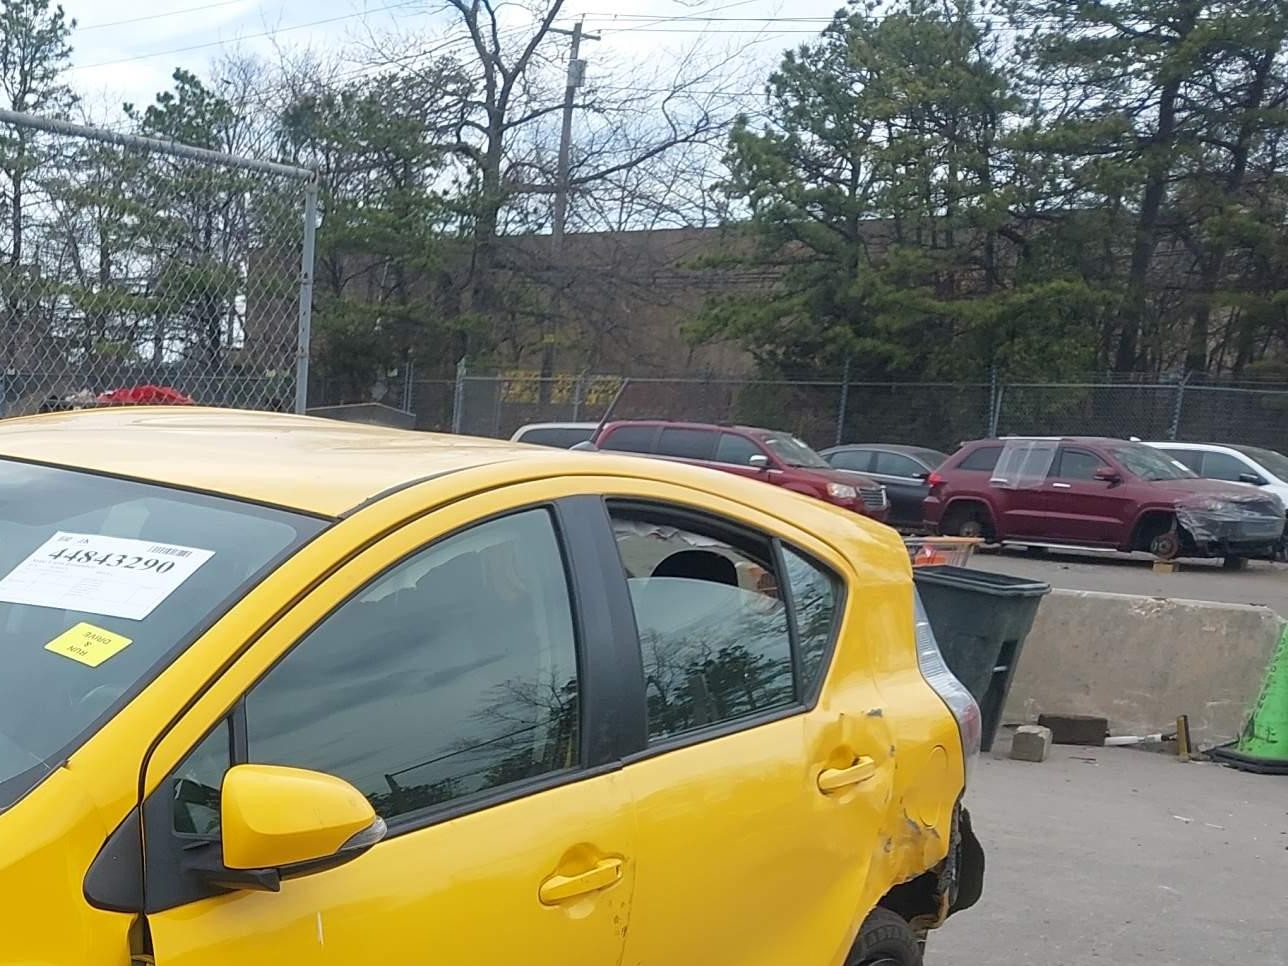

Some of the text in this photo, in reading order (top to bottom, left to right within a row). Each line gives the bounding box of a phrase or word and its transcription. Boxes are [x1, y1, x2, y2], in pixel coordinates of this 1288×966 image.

[48, 548, 175, 574] 44843290
[82, 632, 112, 645] DRIVE
[67, 645, 88, 657] RUN
